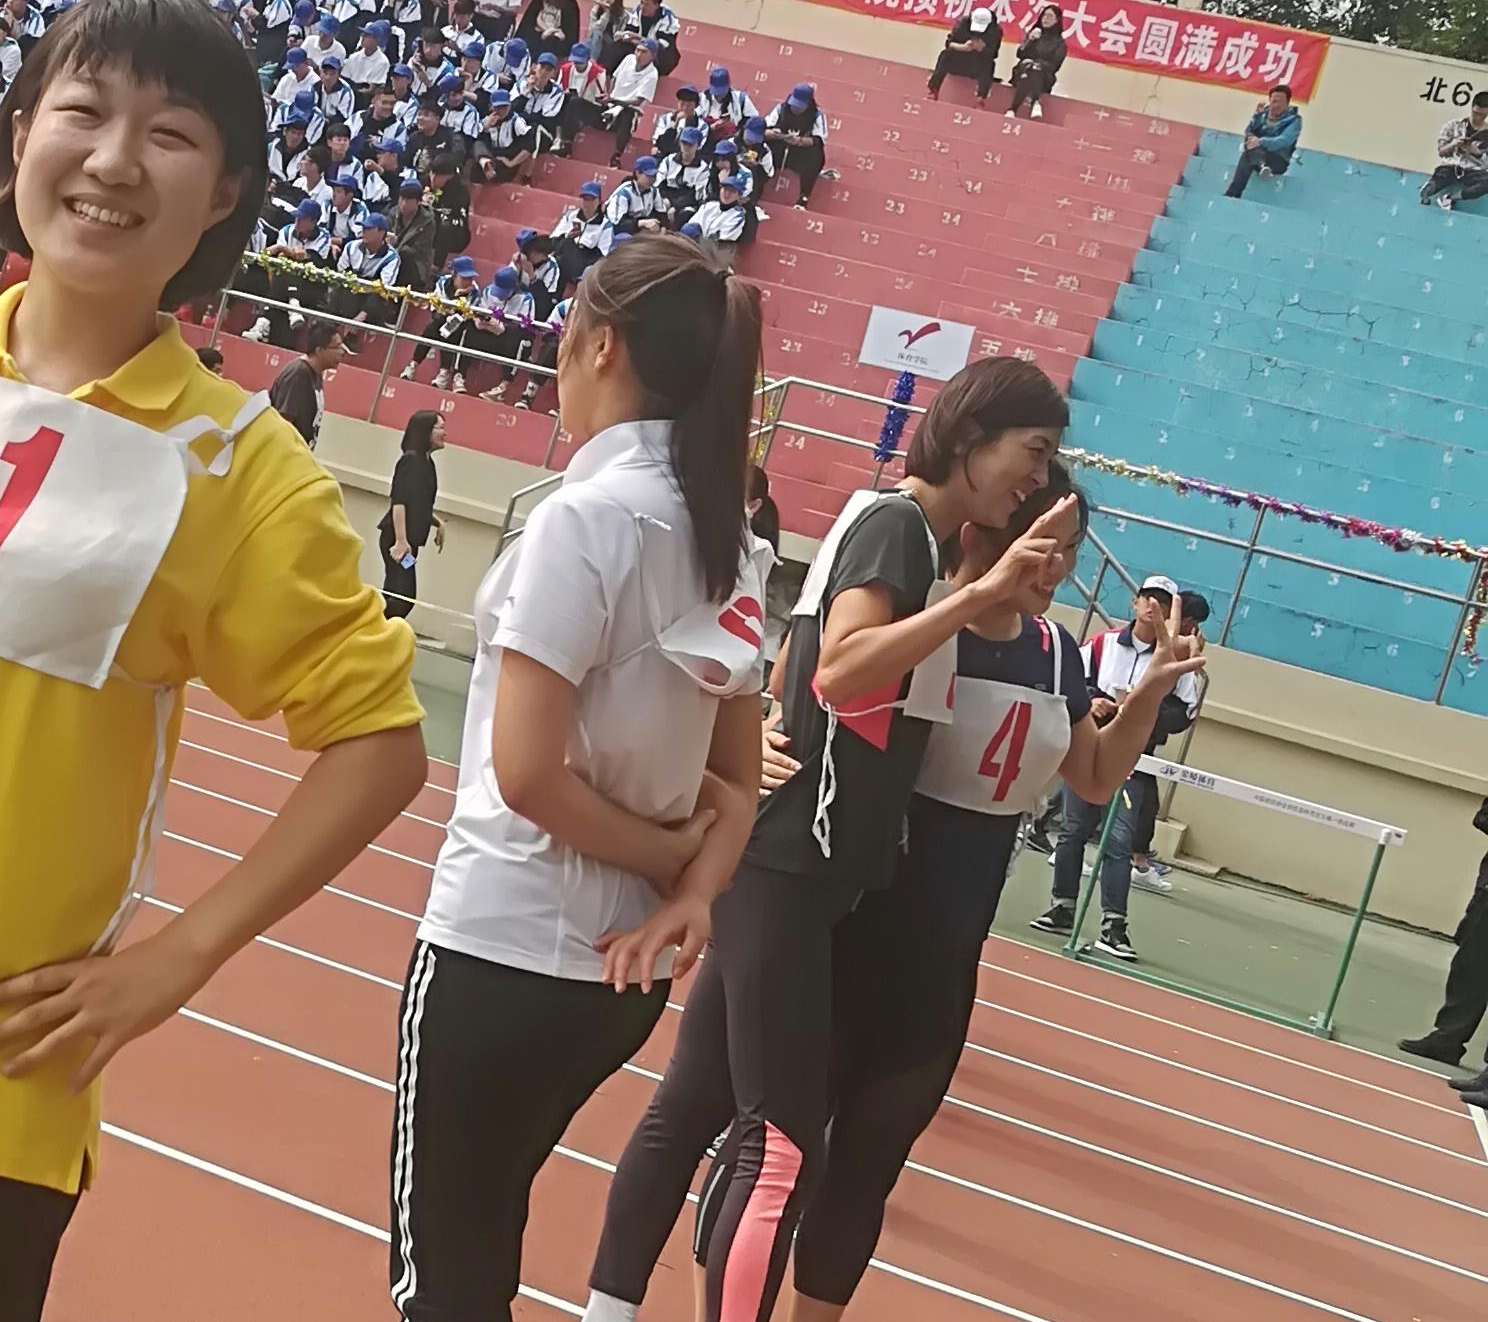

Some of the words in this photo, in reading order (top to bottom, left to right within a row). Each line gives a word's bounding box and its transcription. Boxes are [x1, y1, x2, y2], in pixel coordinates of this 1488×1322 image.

[1420, 76, 1473, 107] 北6
[1002, 122, 1022, 136] 24
[908, 168, 928, 182] 23
[885, 200, 905, 214] 23
[942, 211, 961, 226] 24
[808, 300, 828, 315] 23
[265, 353, 280, 366] 16
[440, 398, 455, 413] 19
[784, 435, 806, 450] 24
[977, 700, 1032, 802] 4
